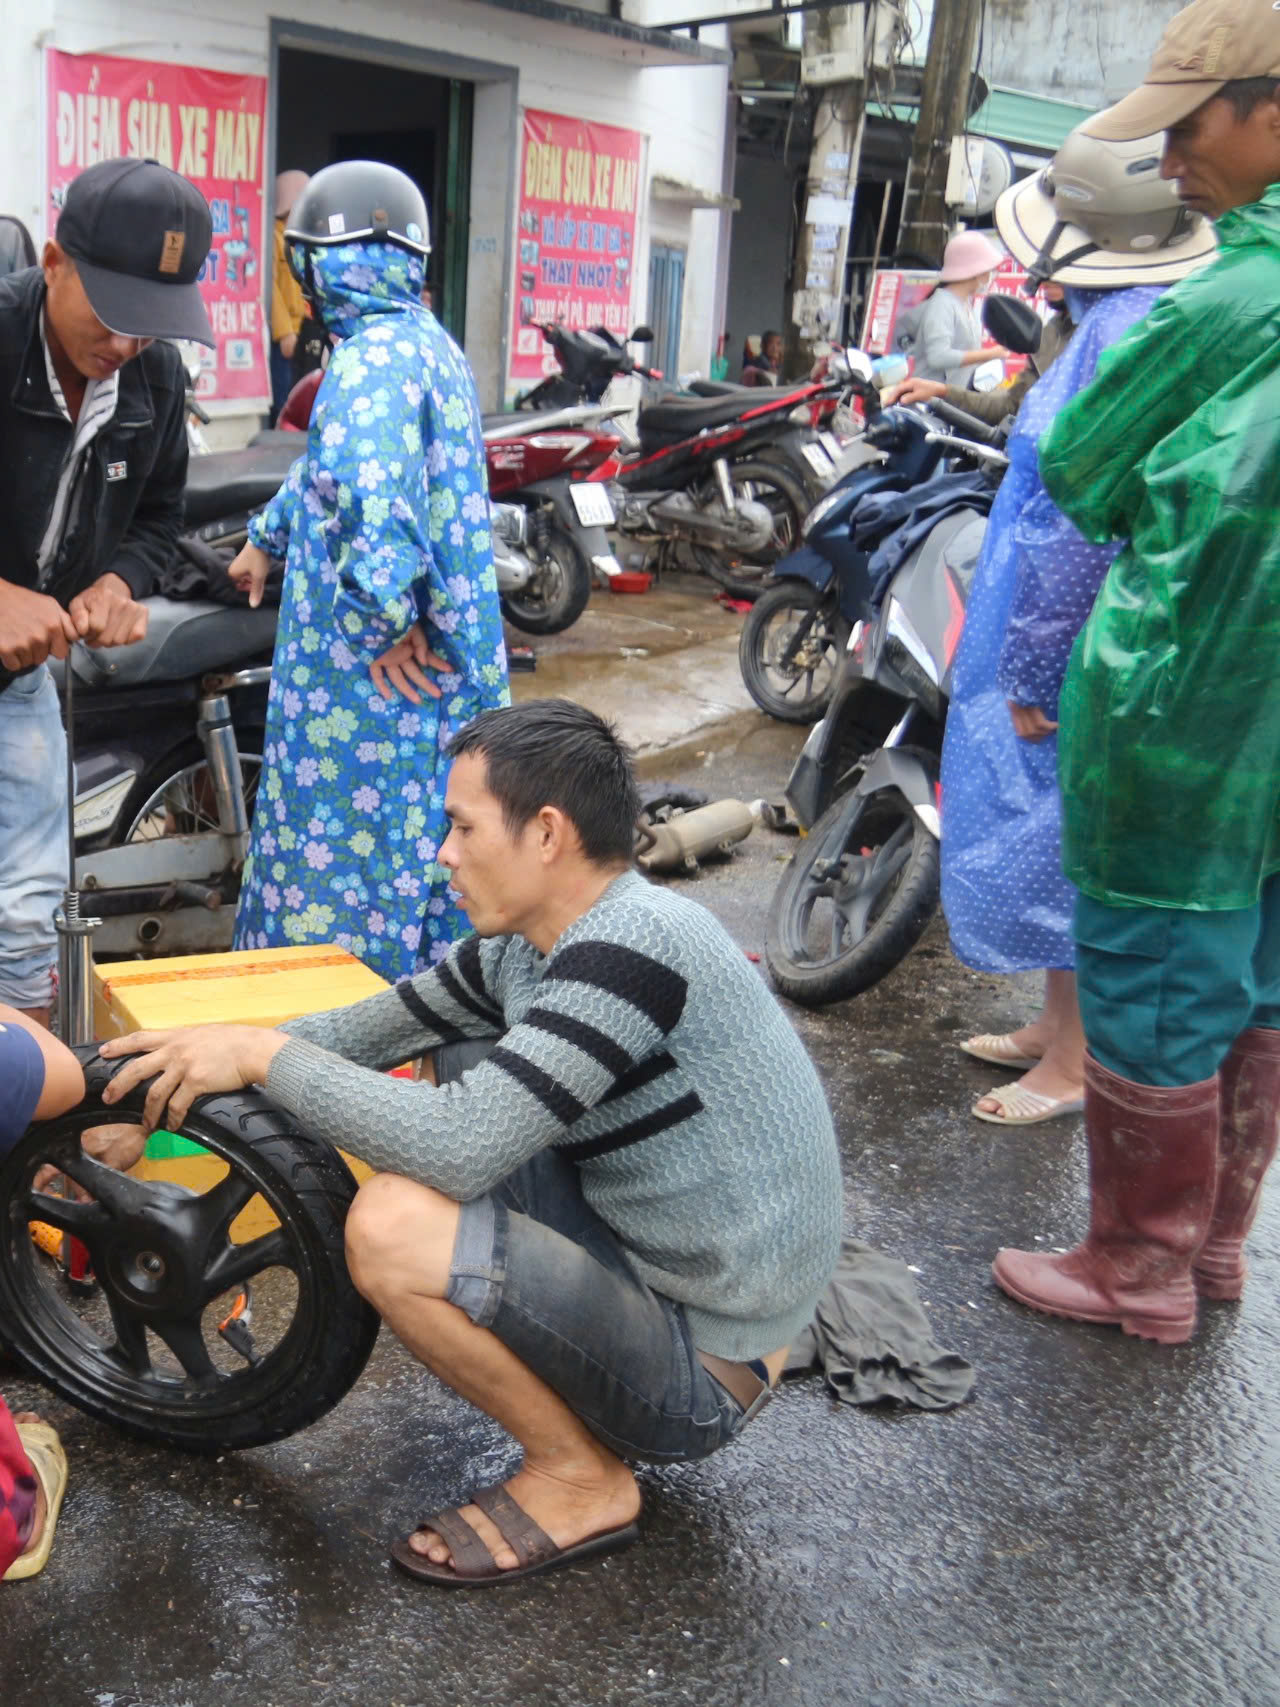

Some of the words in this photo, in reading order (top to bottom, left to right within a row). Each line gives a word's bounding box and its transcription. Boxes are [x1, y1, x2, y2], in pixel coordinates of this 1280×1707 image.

[178, 104, 208, 177] XE
[213, 96, 260, 181] MÁY
[592, 154, 611, 209] XE
[540, 256, 574, 287] THAY
